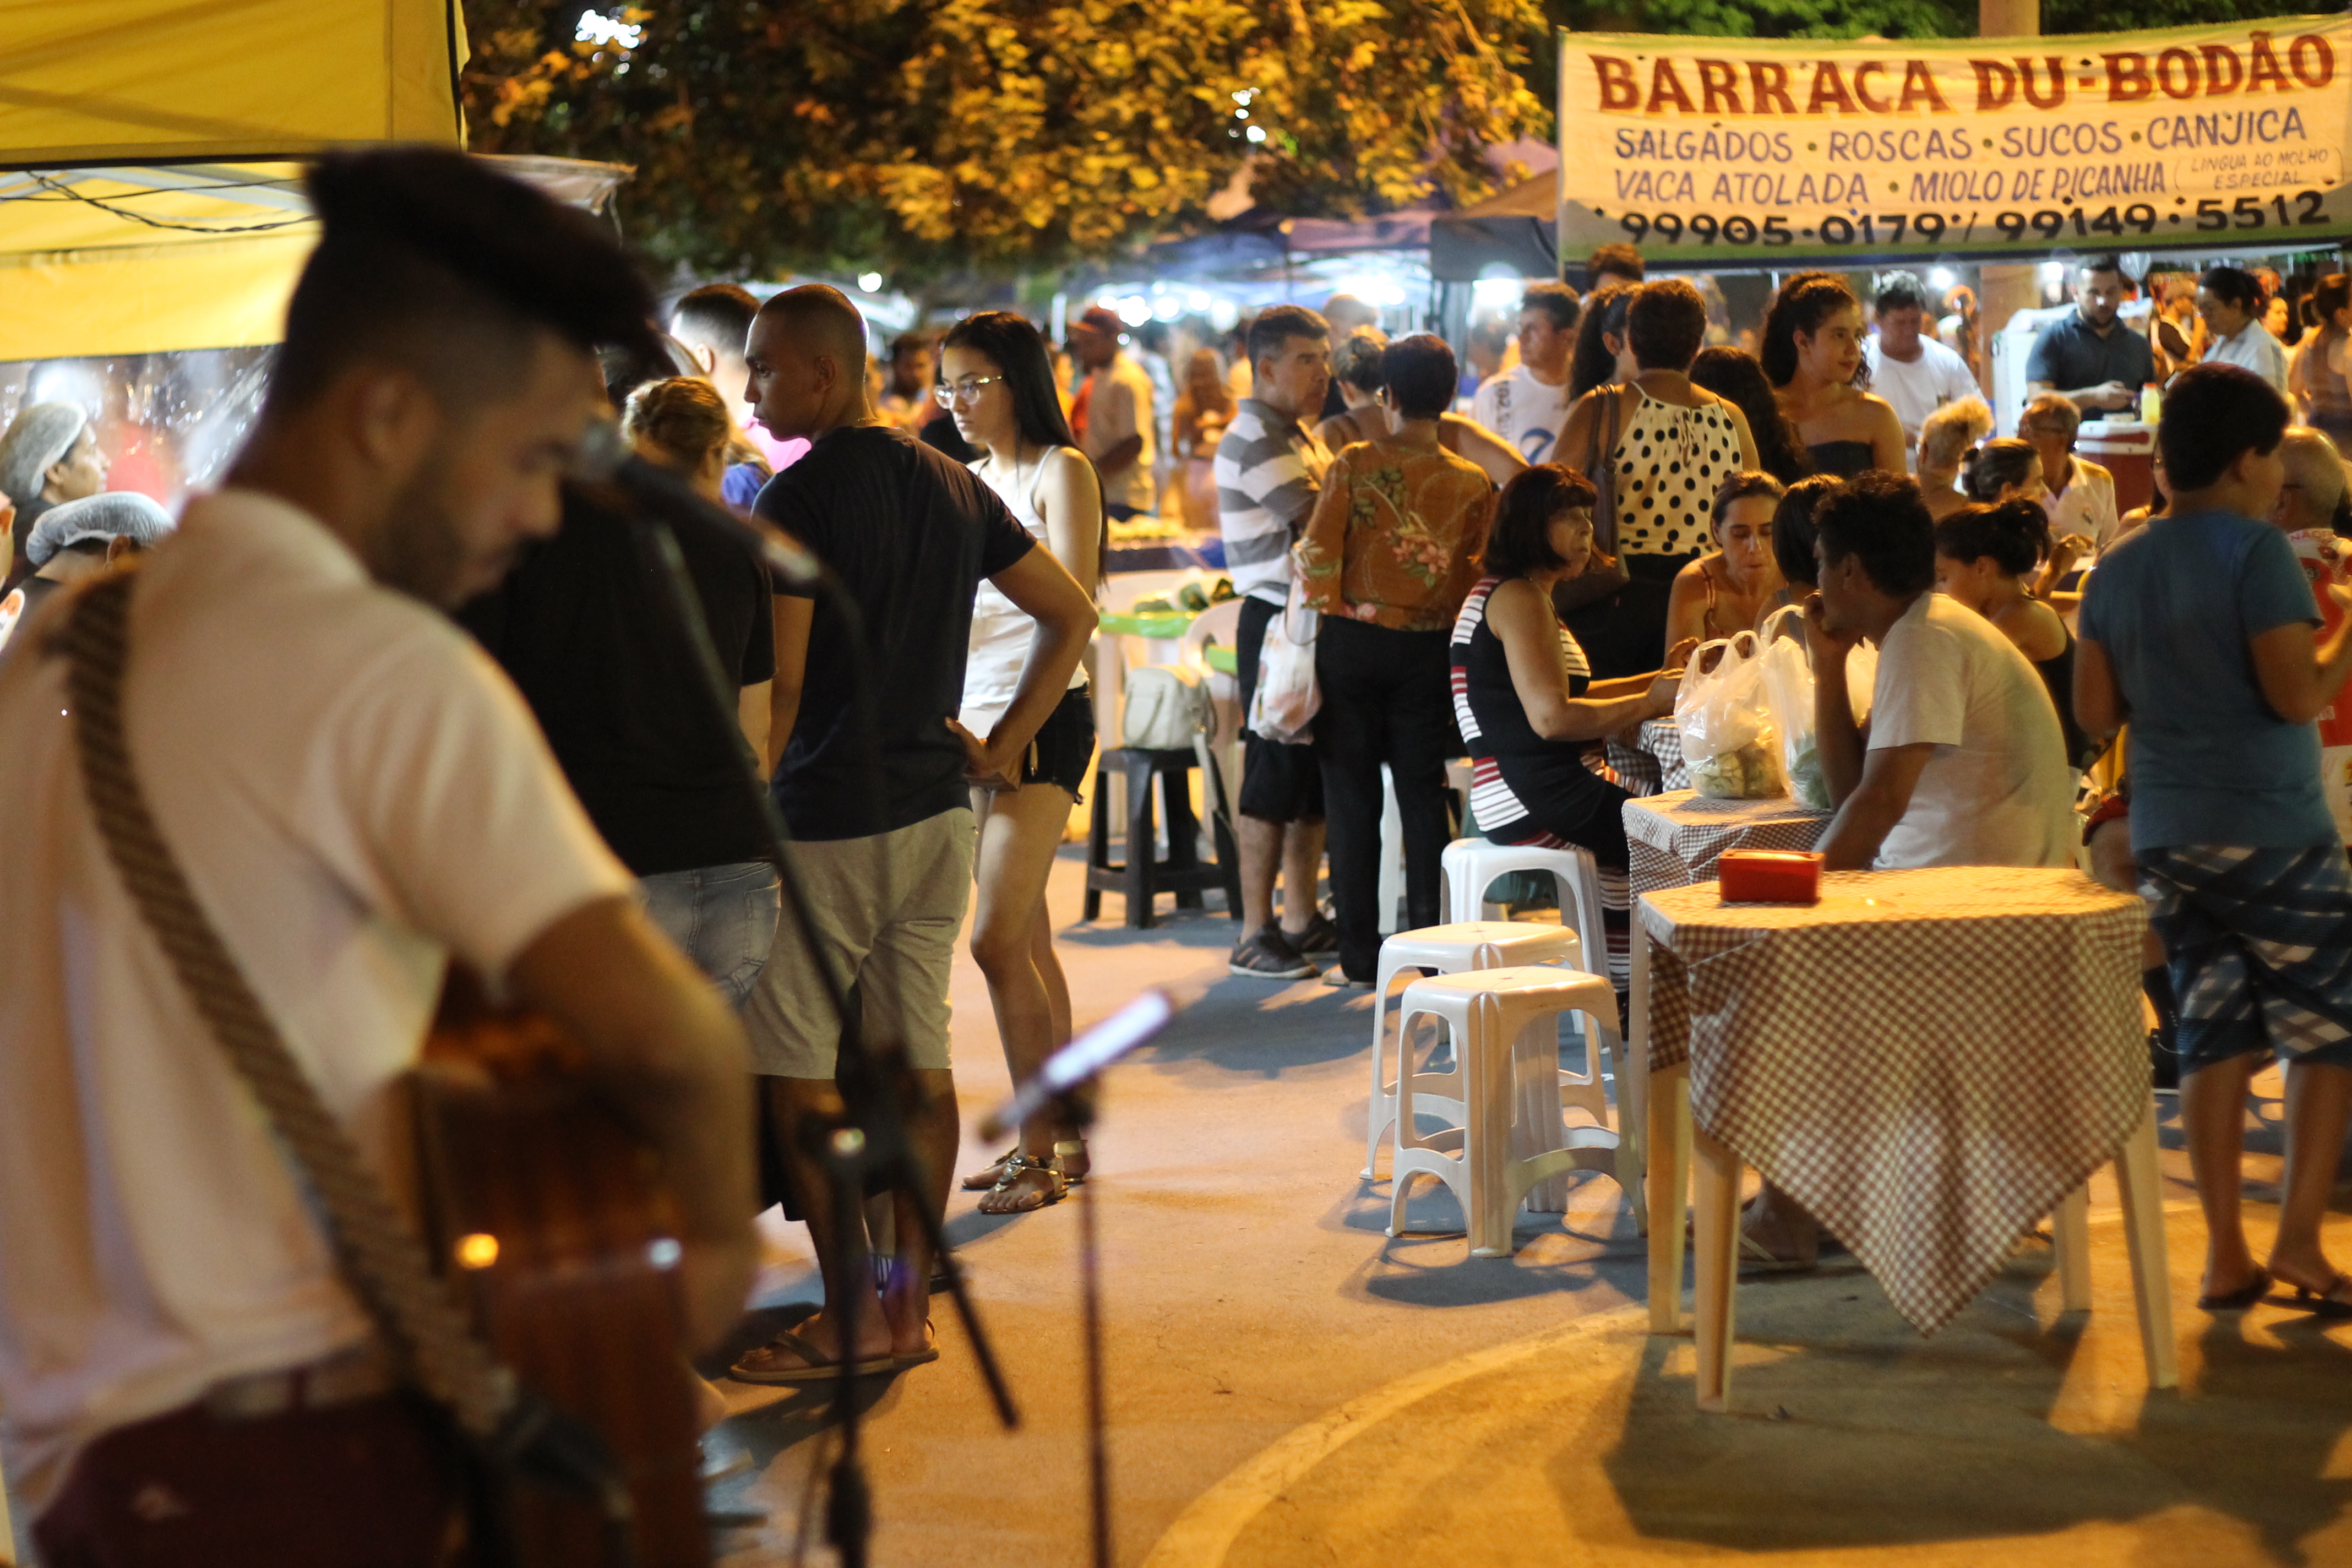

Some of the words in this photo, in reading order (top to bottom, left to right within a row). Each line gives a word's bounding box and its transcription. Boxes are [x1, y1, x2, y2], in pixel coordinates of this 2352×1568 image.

[1589, 54, 1951, 114] BARRACA
[1615, 128, 1793, 162] SALGADOS
[1828, 128, 1973, 162] ROSCAS
[2000, 121, 2124, 159] SUCOS
[2147, 107, 2307, 150] CANJICA
[2254, 152, 2273, 167] AO
[2278, 149, 2329, 166] MOLHO
[1615, 169, 1695, 202] VACA
[1712, 172, 1870, 204] ATOLADA
[1909, 170, 2004, 203] MIOLO
[2012, 168, 2045, 202] DE
[2050, 161, 2166, 199] PICANHA
[2214, 170, 2302, 190] ESPECIAL
